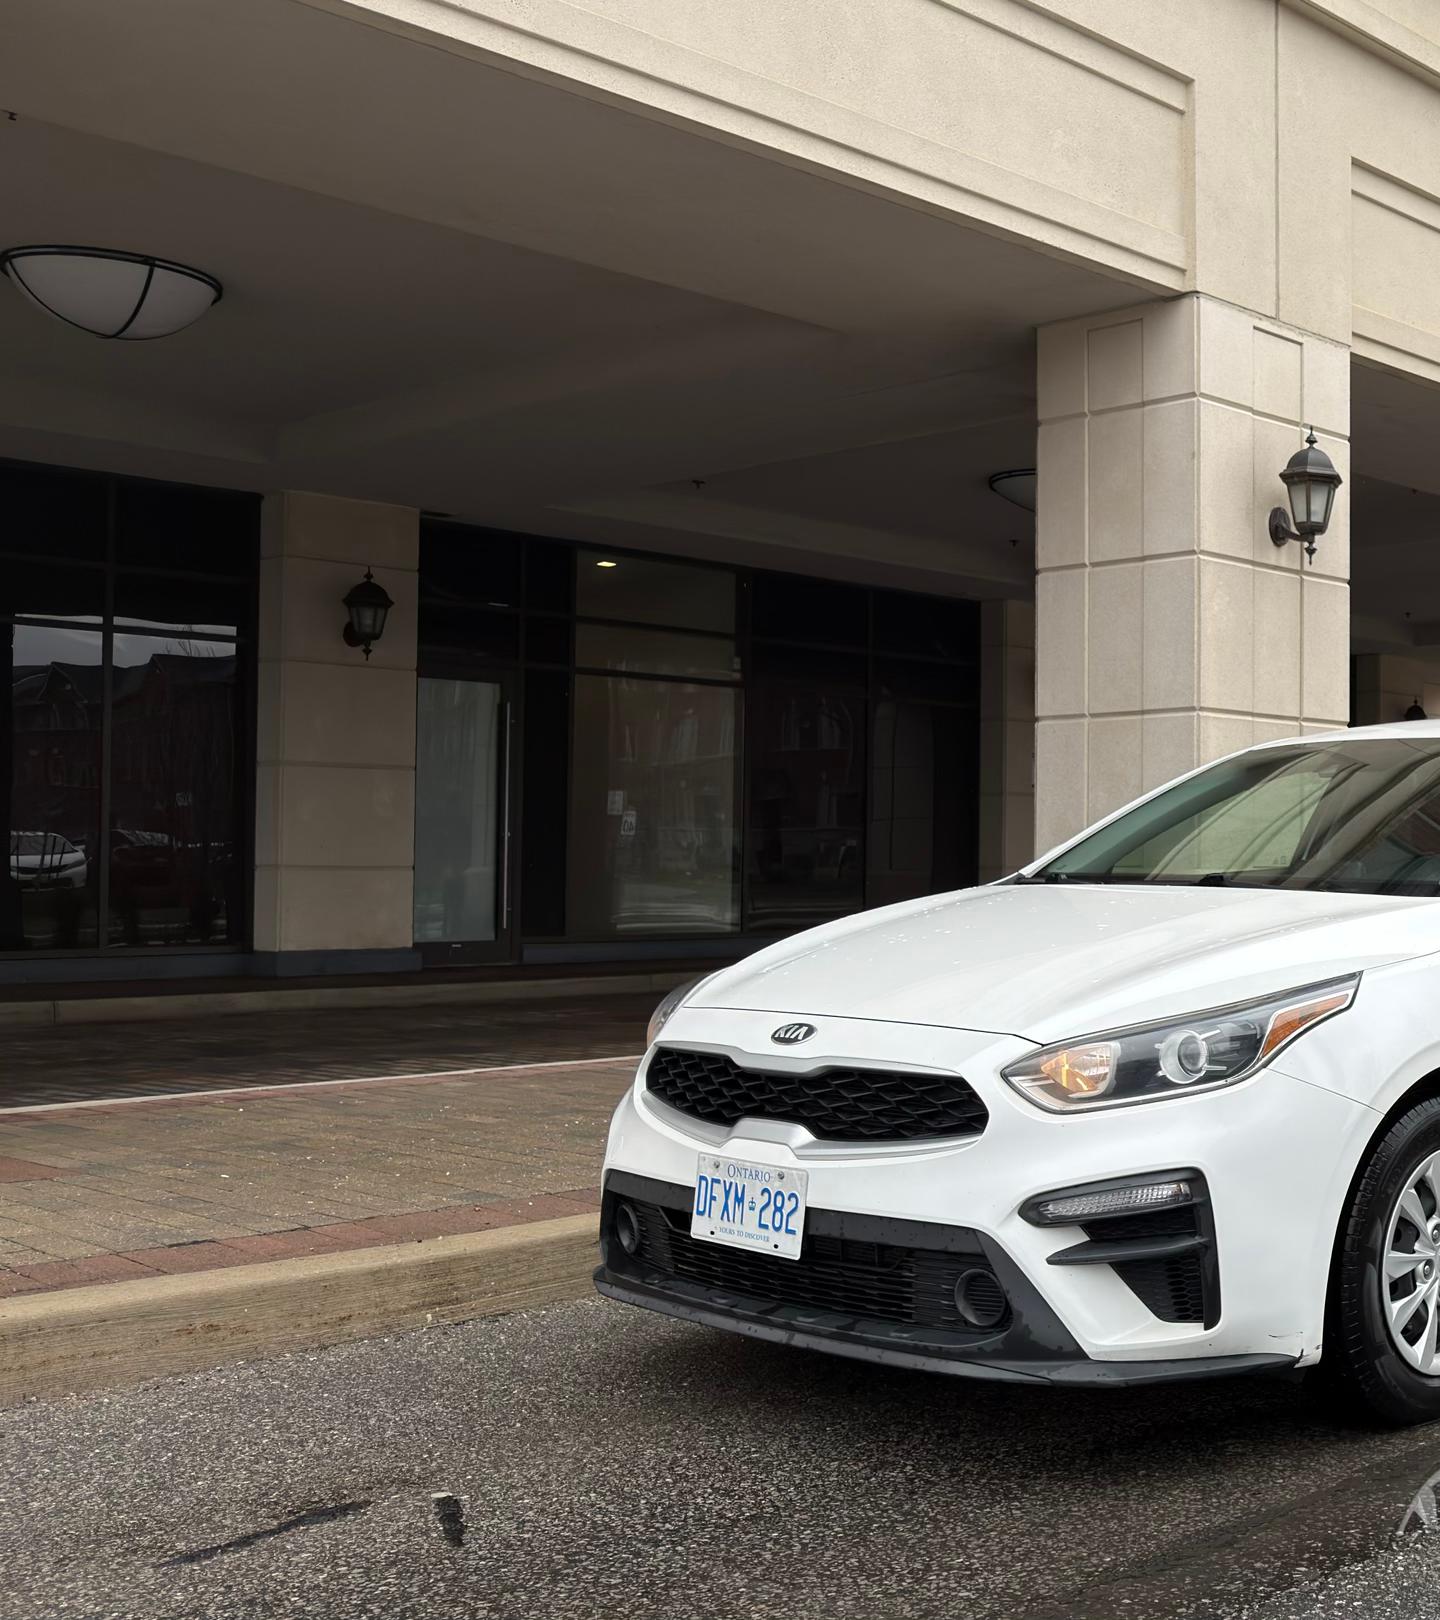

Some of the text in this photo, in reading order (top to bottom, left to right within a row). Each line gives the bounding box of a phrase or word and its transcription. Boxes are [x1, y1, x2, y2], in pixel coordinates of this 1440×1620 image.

[775, 1024, 809, 1040] KIA
[727, 1164, 771, 1183] ONTARIO
[695, 1175, 800, 1236] DFXM 282
[719, 1226, 735, 1235] YOURS
[744, 1231, 770, 1242] DISCOVER
